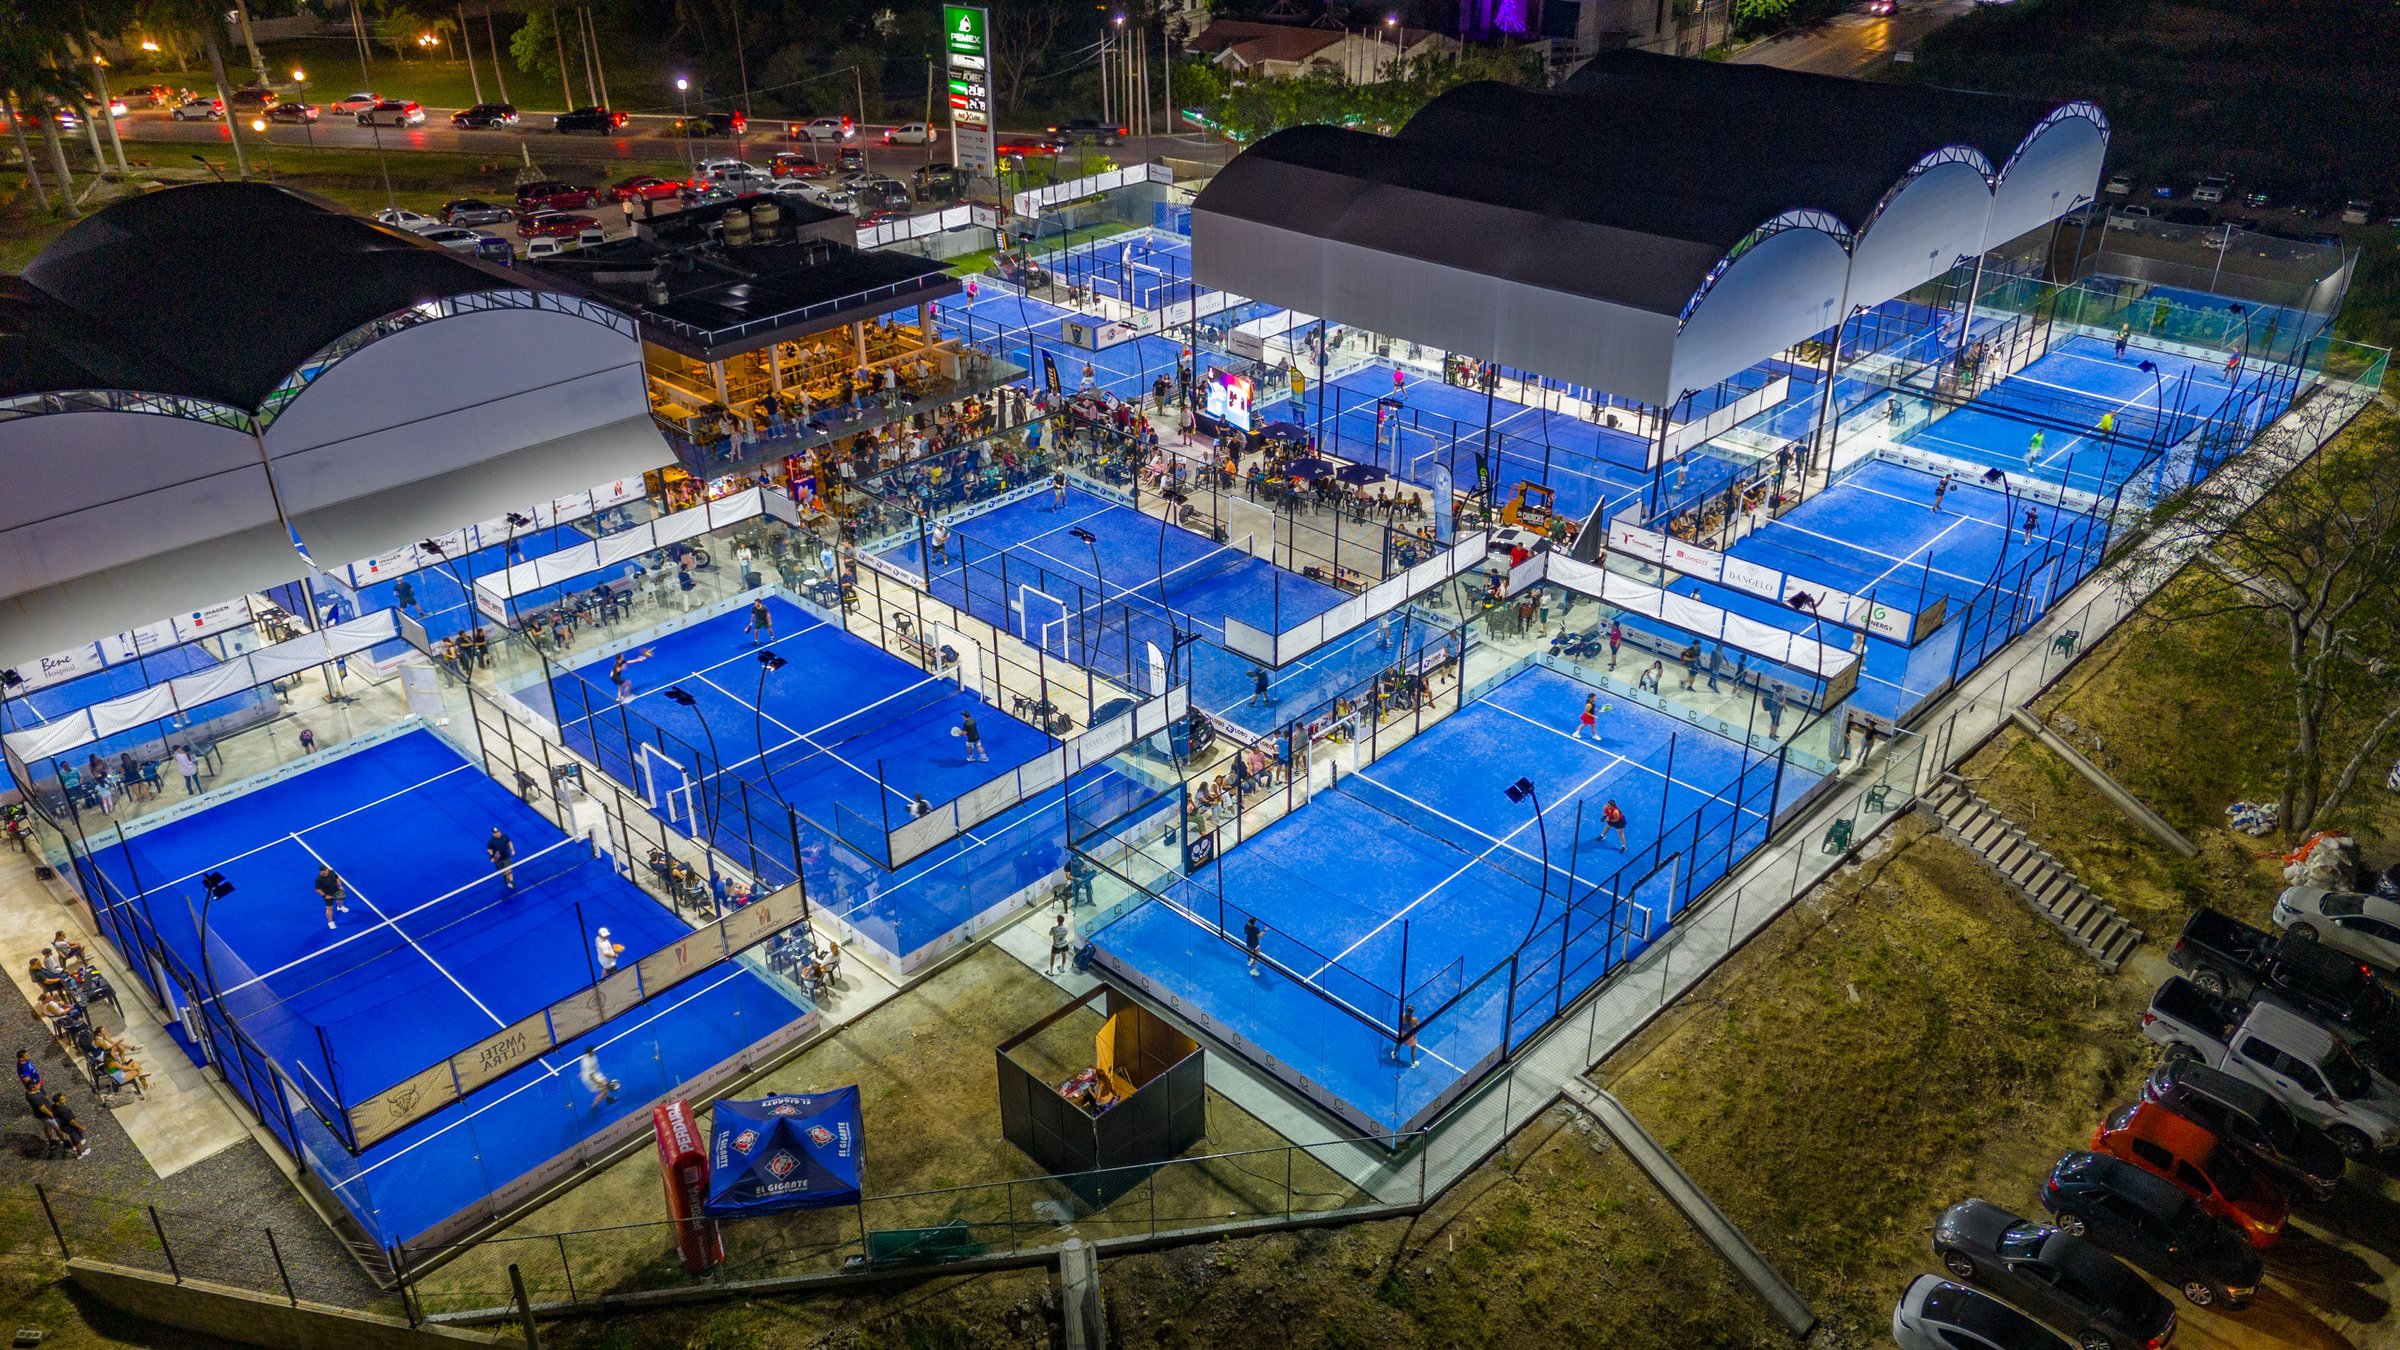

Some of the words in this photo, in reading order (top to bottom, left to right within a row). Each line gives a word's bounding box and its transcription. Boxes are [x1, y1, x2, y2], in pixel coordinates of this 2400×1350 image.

[951, 33, 981, 44] PEMEX
[1480, 467, 1489, 511] GENRGY
[1728, 570, 1773, 593] DANGELO
[203, 605, 230, 617] IMAGEN
[1861, 614, 1894, 633] GNERGY
[40, 654, 72, 673] Bene
[44, 664, 77, 679] Hospital
[1234, 727, 1248, 739] LOBO
[665, 1101, 694, 1154] PERDURA
[755, 1185, 766, 1195] EL
[767, 1179, 808, 1192] GIGANTE
